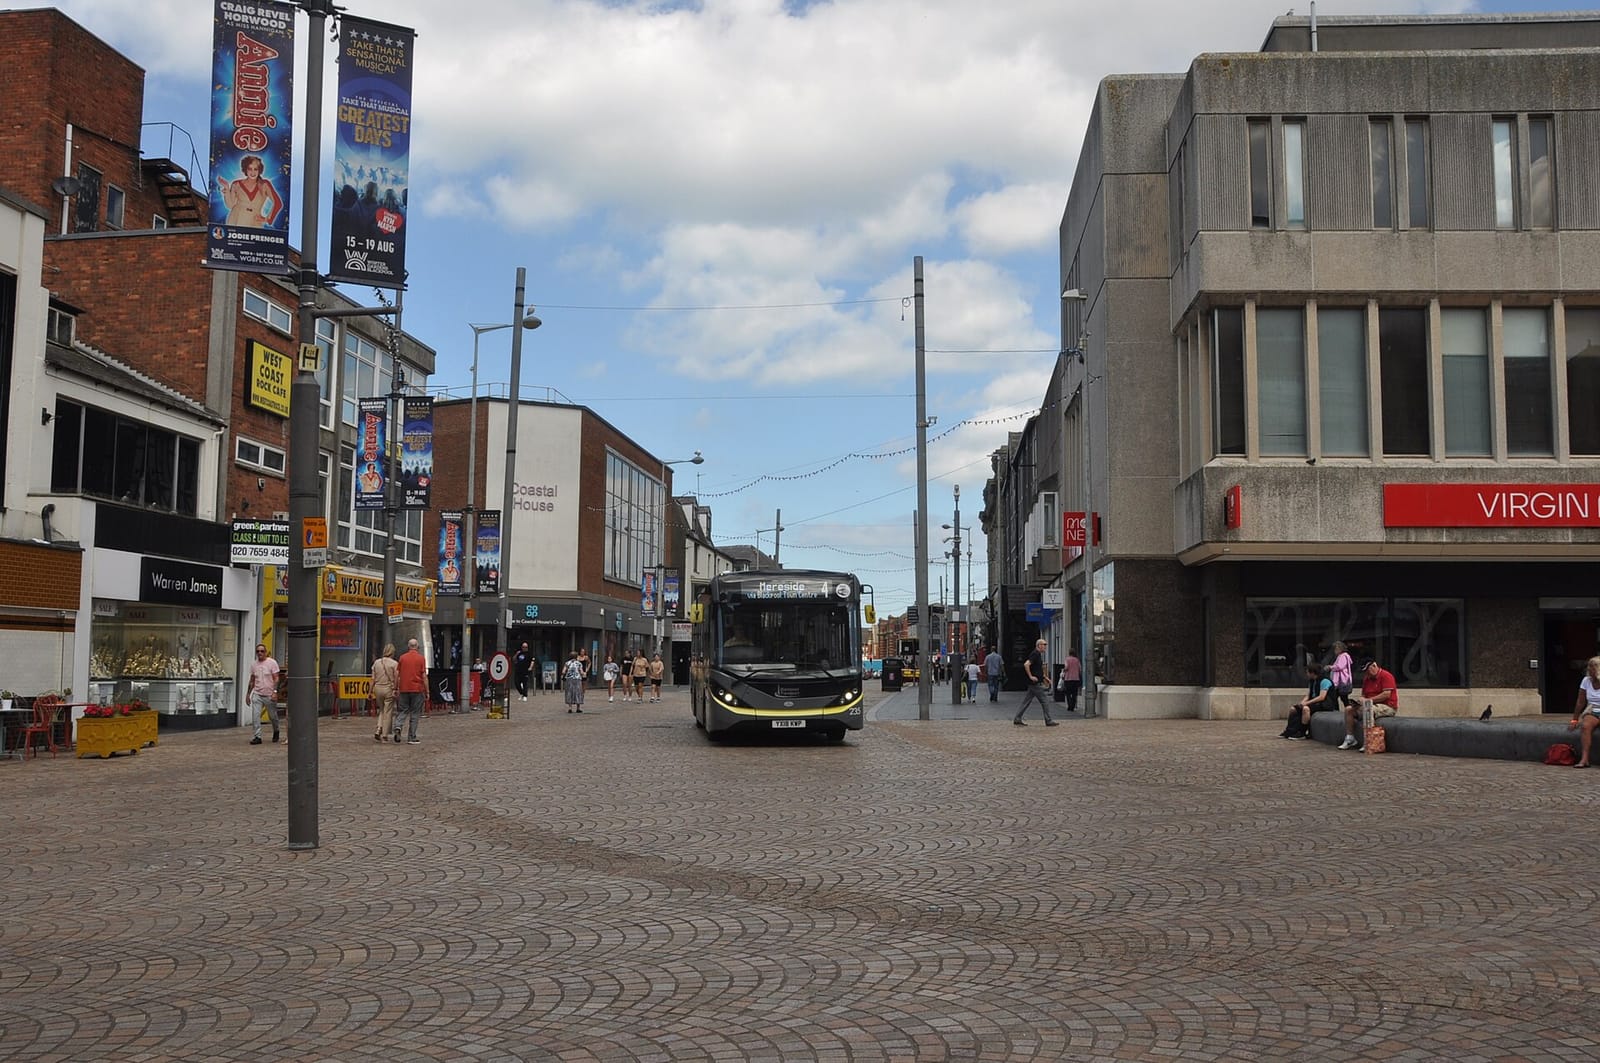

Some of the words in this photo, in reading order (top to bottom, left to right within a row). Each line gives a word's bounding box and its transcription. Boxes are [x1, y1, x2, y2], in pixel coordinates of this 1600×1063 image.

[220, 2, 256, 15] CRAIG
[257, 8, 291, 21] REVEL
[224, 12, 287, 29] HORWOOD
[346, 47, 407, 67] SENSATIONAL
[376, 44, 404, 58] THAT'S
[233, 31, 279, 152] Annie
[342, 97, 359, 106] TAKE
[360, 100, 378, 109] THAT
[378, 104, 409, 116] MUSICAL
[338, 104, 410, 134] GREATEST
[354, 124, 392, 148] DAYS
[227, 232, 250, 241] JODIE
[250, 234, 285, 244] PRENGER
[346, 235, 356, 248] 15
[365, 238, 376, 250] 19
[377, 240, 395, 253] AUG
[263, 349, 283, 370] WEST
[259, 364, 284, 385] COAST
[256, 378, 272, 393] ROCK
[272, 385, 287, 399] CAFE
[513, 497, 555, 512] House
[1477, 492, 1589, 519] VIRGIN
[233, 532, 252, 543] CLASS
[257, 534, 271, 544] UNIT
[272, 534, 280, 544] TO
[1066, 529, 1085, 541] NE
[232, 546, 248, 556] 020
[249, 547, 269, 557] 7659
[270, 548, 290, 558] 4848
[151, 572, 187, 591] Warren
[189, 577, 218, 595] James
[341, 577, 362, 595] WEST
[405, 587, 420, 603] CAFE
[759, 582, 806, 591] Mereside
[821, 581, 829, 599] 4
[181, 612, 201, 620] SALE
[495, 660, 503, 674] 5
[344, 681, 361, 695] WEST
[849, 708, 861, 716] 235
